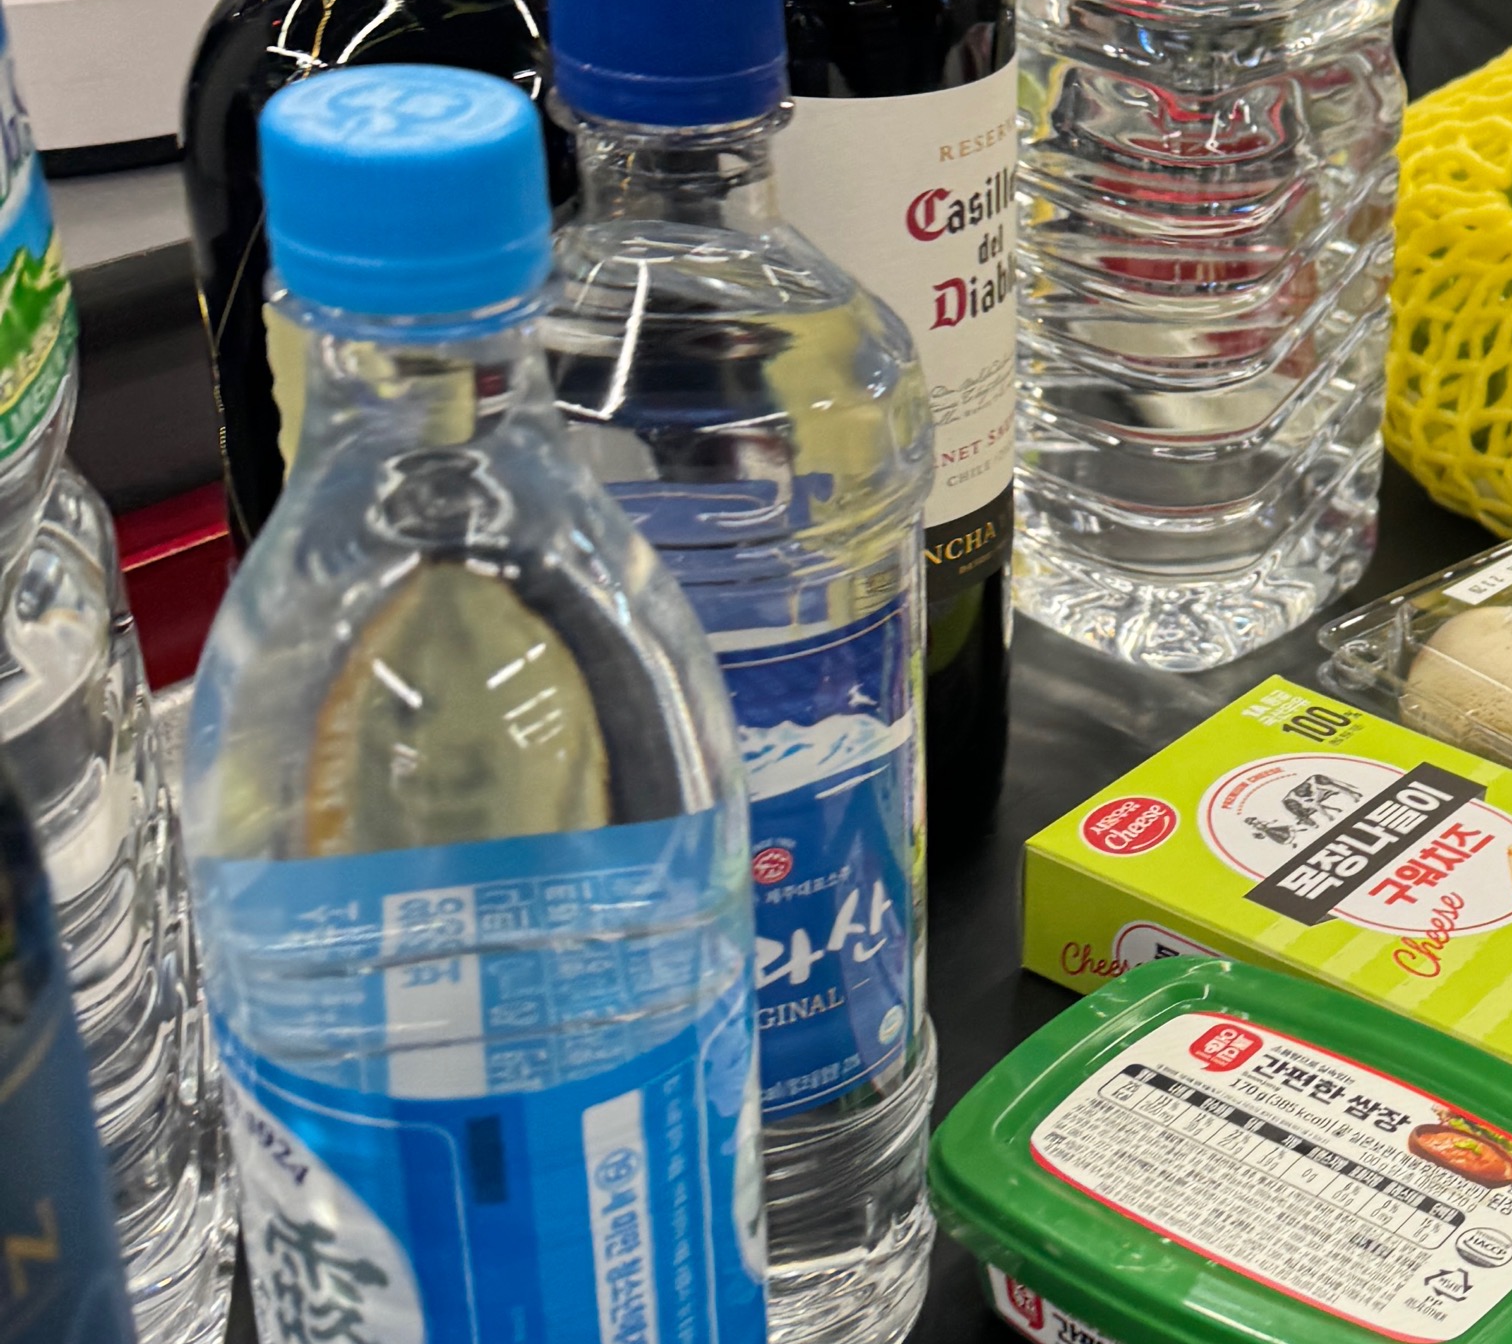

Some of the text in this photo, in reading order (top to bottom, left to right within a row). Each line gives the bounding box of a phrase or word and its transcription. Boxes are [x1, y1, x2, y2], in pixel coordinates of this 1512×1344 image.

[978, 223, 1004, 265] del
[934, 438, 983, 469] NET
[946, 459, 991, 488] CHILE
[925, 520, 997, 565] NCHA
[1104, 804, 1167, 850] Cheese
[1276, 781, 1454, 900] 목장나들이
[1367, 822, 1496, 906] 구워치즈
[755, 879, 894, 990] 라산
[1392, 891, 1465, 979] Cheese
[1061, 941, 1131, 978] Chees
[758, 986, 845, 1030] GINAL
[1252, 1054, 1346, 1106] 간편한
[1344, 1095, 1412, 1133] 쌈장
[1469, 1234, 1508, 1257] HACCP
